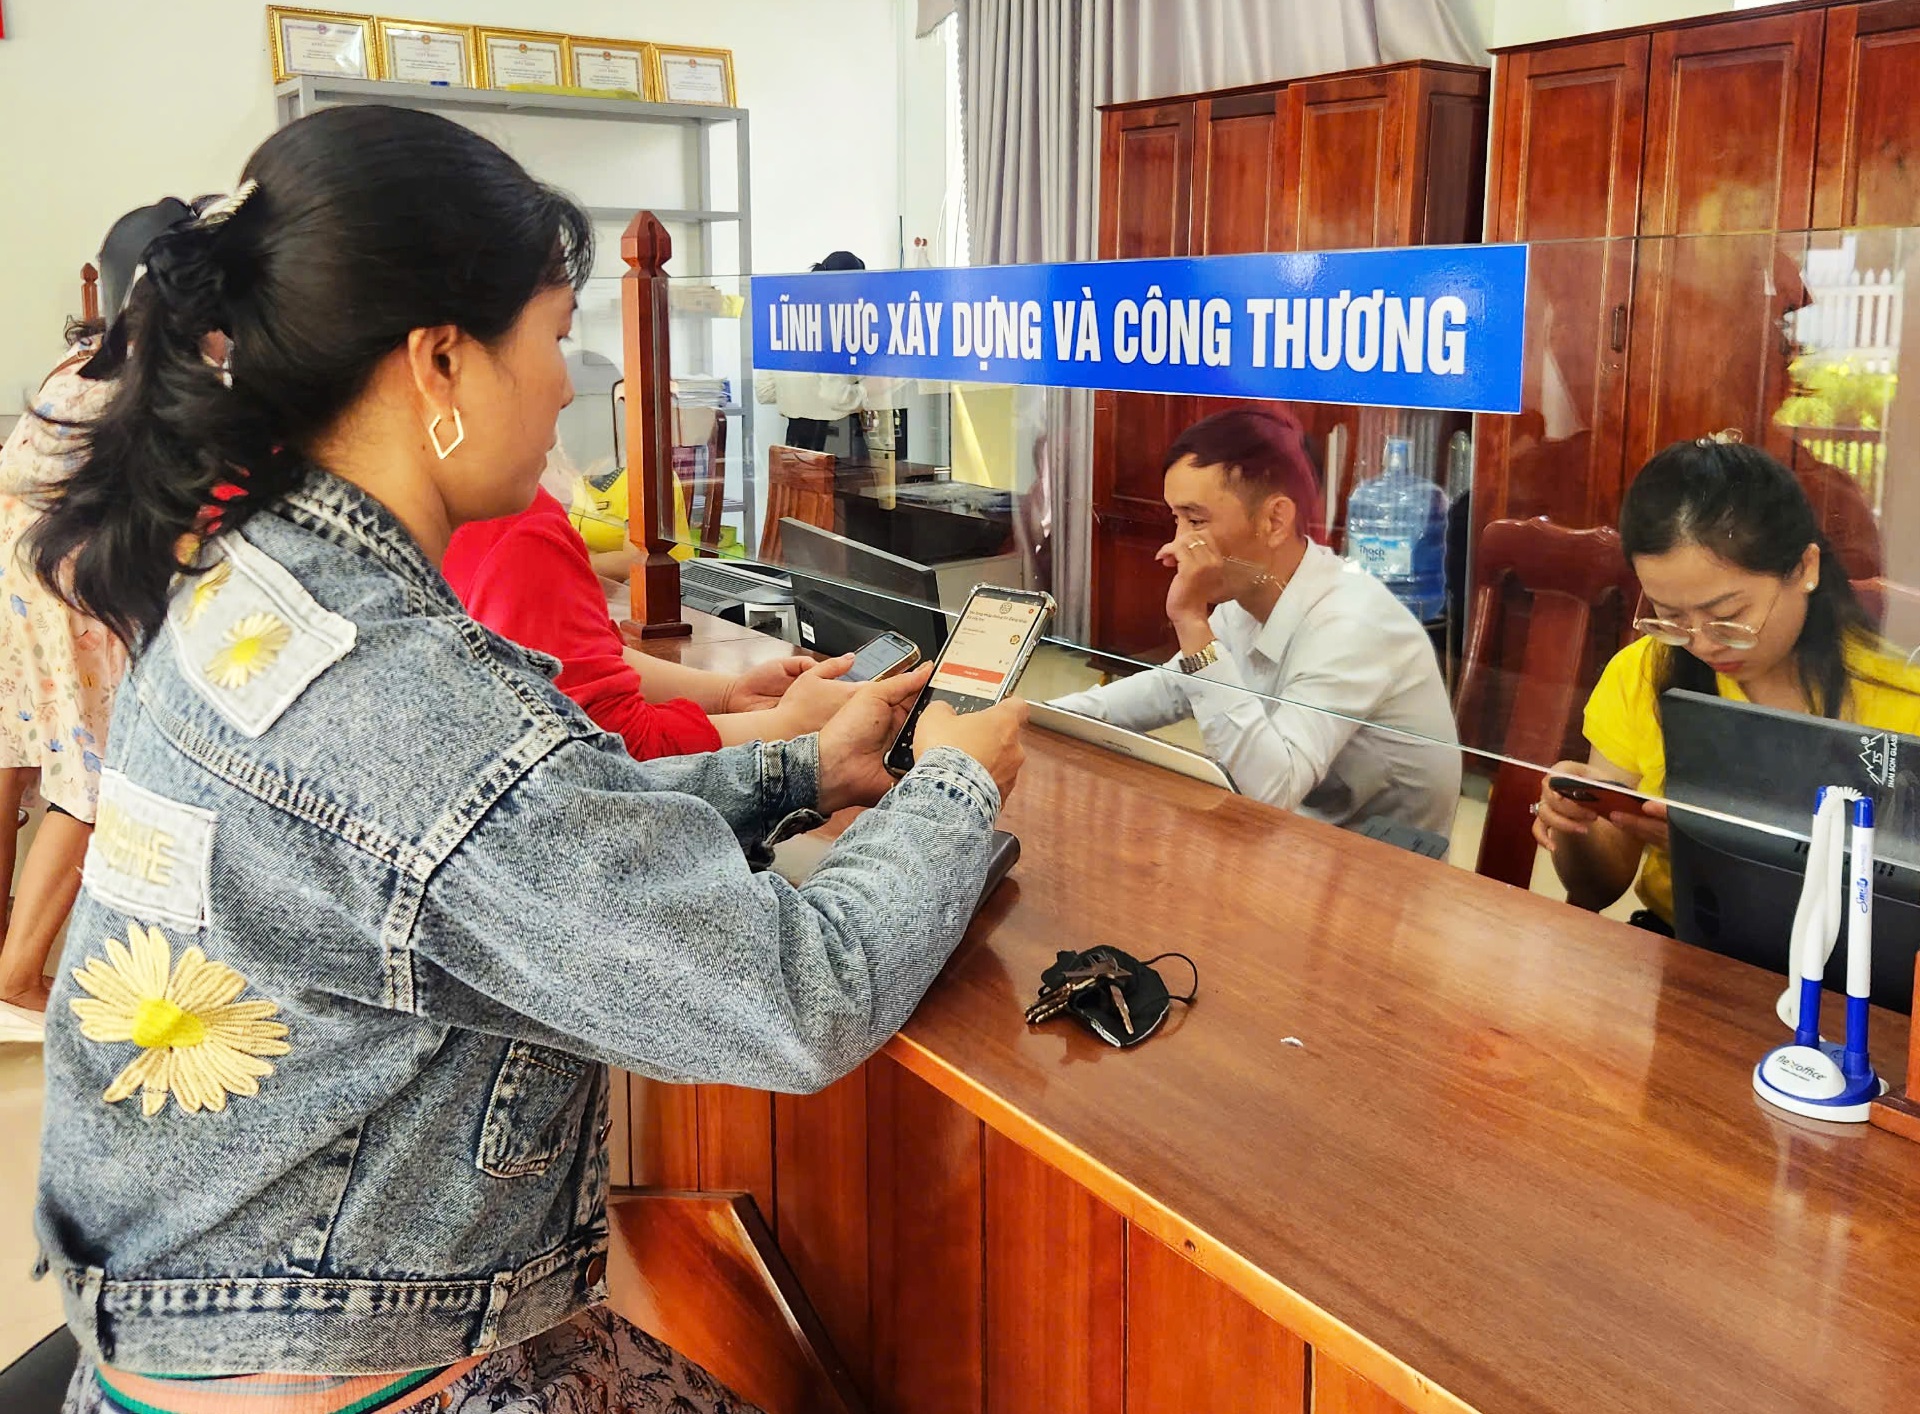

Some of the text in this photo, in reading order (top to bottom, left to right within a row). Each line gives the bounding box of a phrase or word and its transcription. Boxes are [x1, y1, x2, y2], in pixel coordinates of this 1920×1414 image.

[769, 285, 1468, 375] LĨNH VỰC XÂY DỰNG VÀ CÔNG THƯƠNG
[1888, 757, 1896, 773] SON
